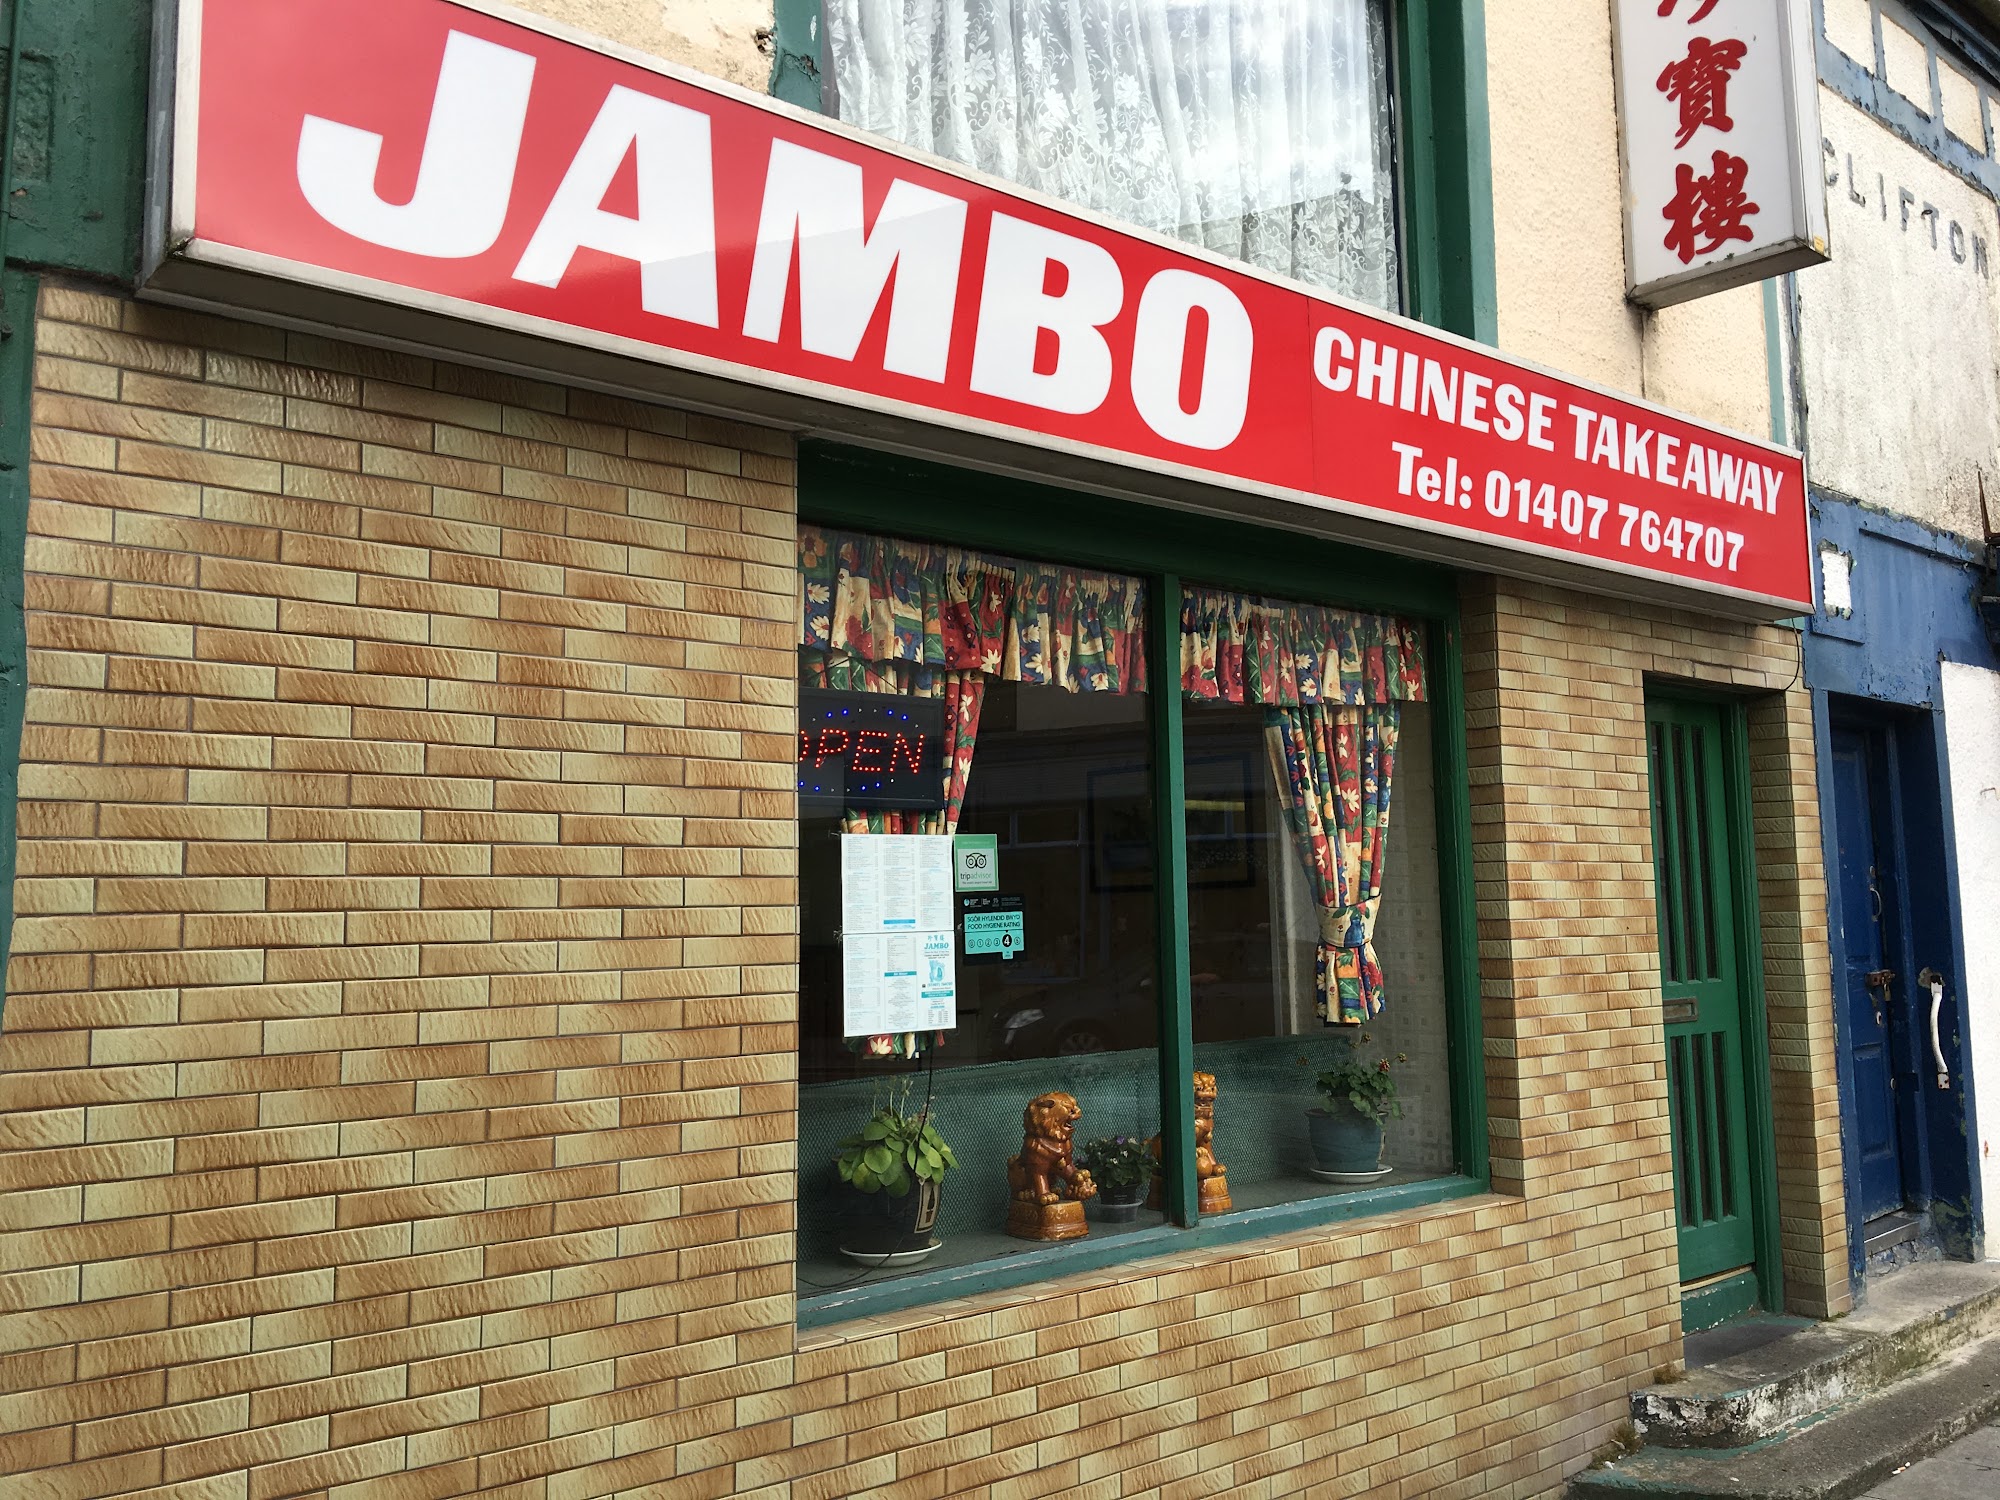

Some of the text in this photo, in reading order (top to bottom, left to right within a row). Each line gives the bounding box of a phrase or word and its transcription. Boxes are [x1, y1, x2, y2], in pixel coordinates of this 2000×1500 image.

[1655, 0, 1760, 265] 寶樓
[297, 28, 1255, 451] JAMBO
[1313, 326, 1784, 516] CHINESE TAKEAWAY
[1391, 441, 1745, 573] Tel: 01407 764707
[960, 872, 992, 881] tripadvisor
[1003, 935, 1011, 946] 4
[923, 942, 950, 950] JAMBO
